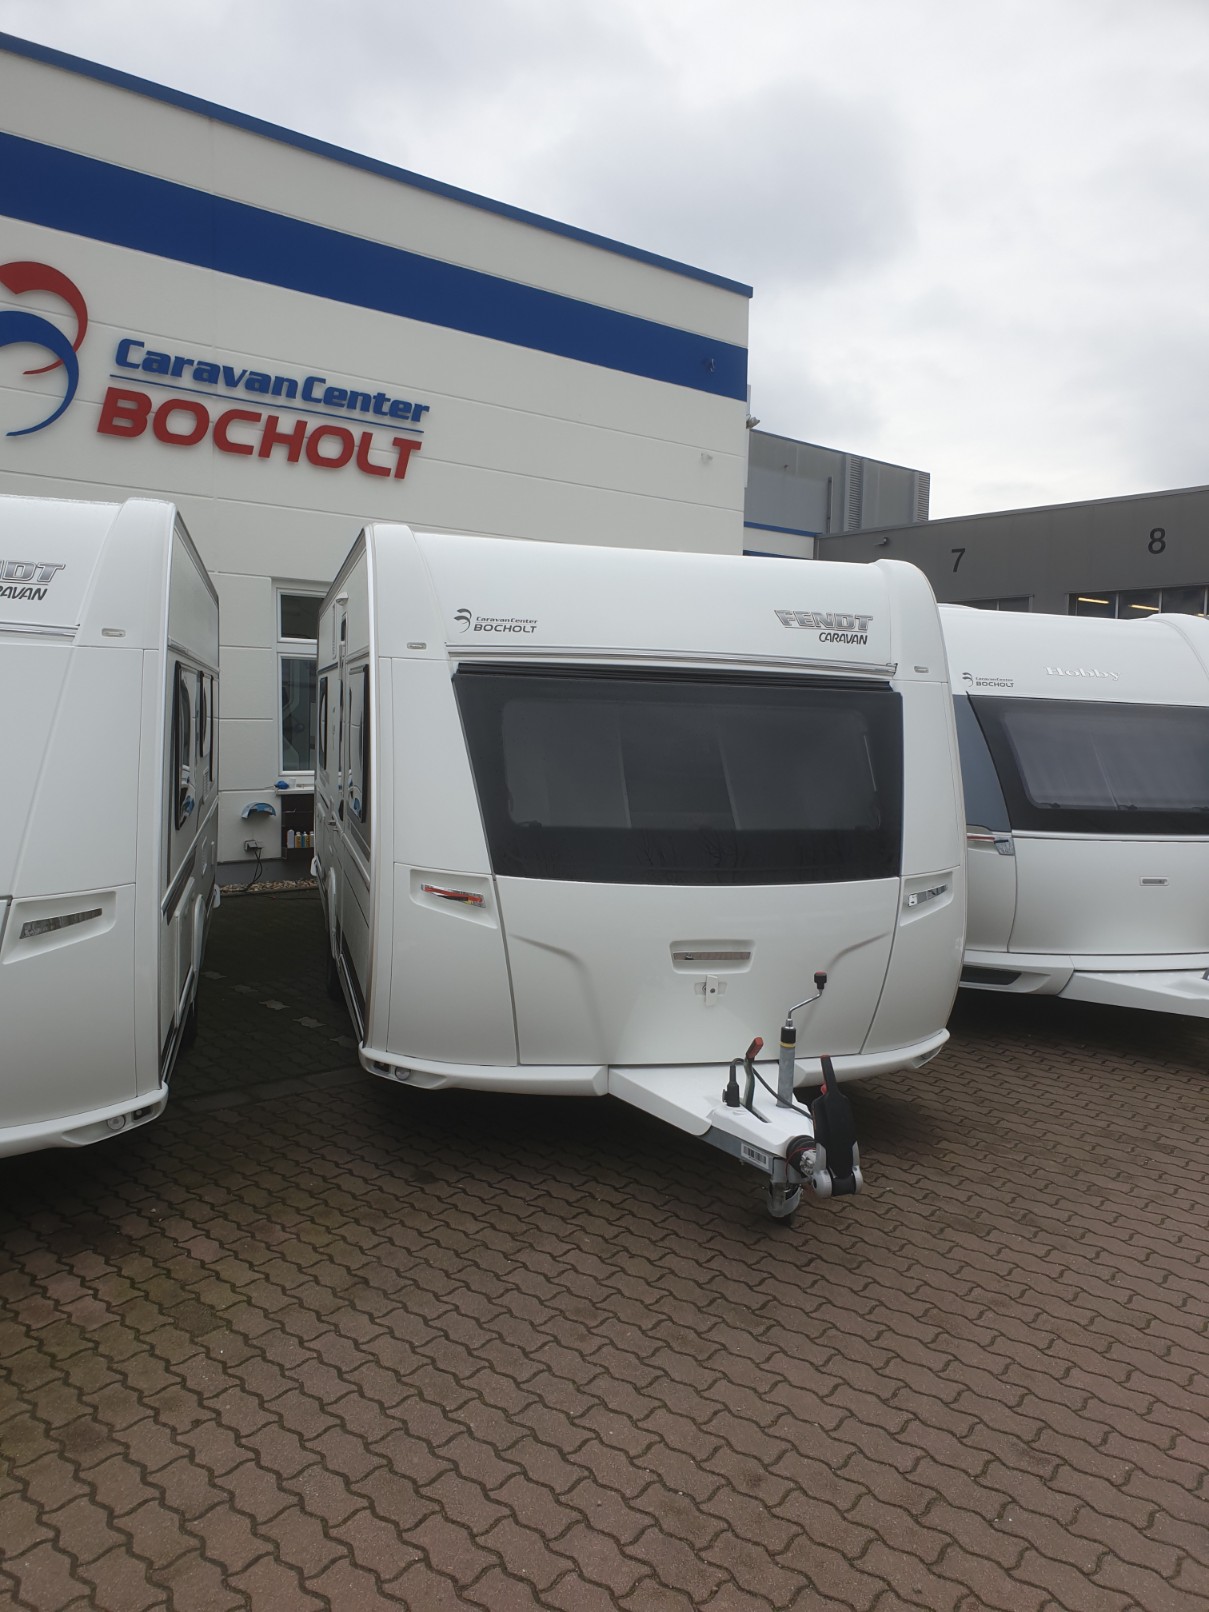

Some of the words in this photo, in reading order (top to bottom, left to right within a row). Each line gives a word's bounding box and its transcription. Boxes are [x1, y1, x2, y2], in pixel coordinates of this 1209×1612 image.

[115, 338, 430, 423] CaravanCenter
[97, 387, 422, 480] BOCHOLT
[1148, 527, 1167, 554] 8
[0, 560, 66, 582] DT
[951, 548, 966, 573] 7
[474, 624, 537, 633] BOCHOLT
[773, 609, 874, 631] FENDT
[819, 632, 868, 645] CARAVAN
[1045, 666, 1120, 681] Hobby
